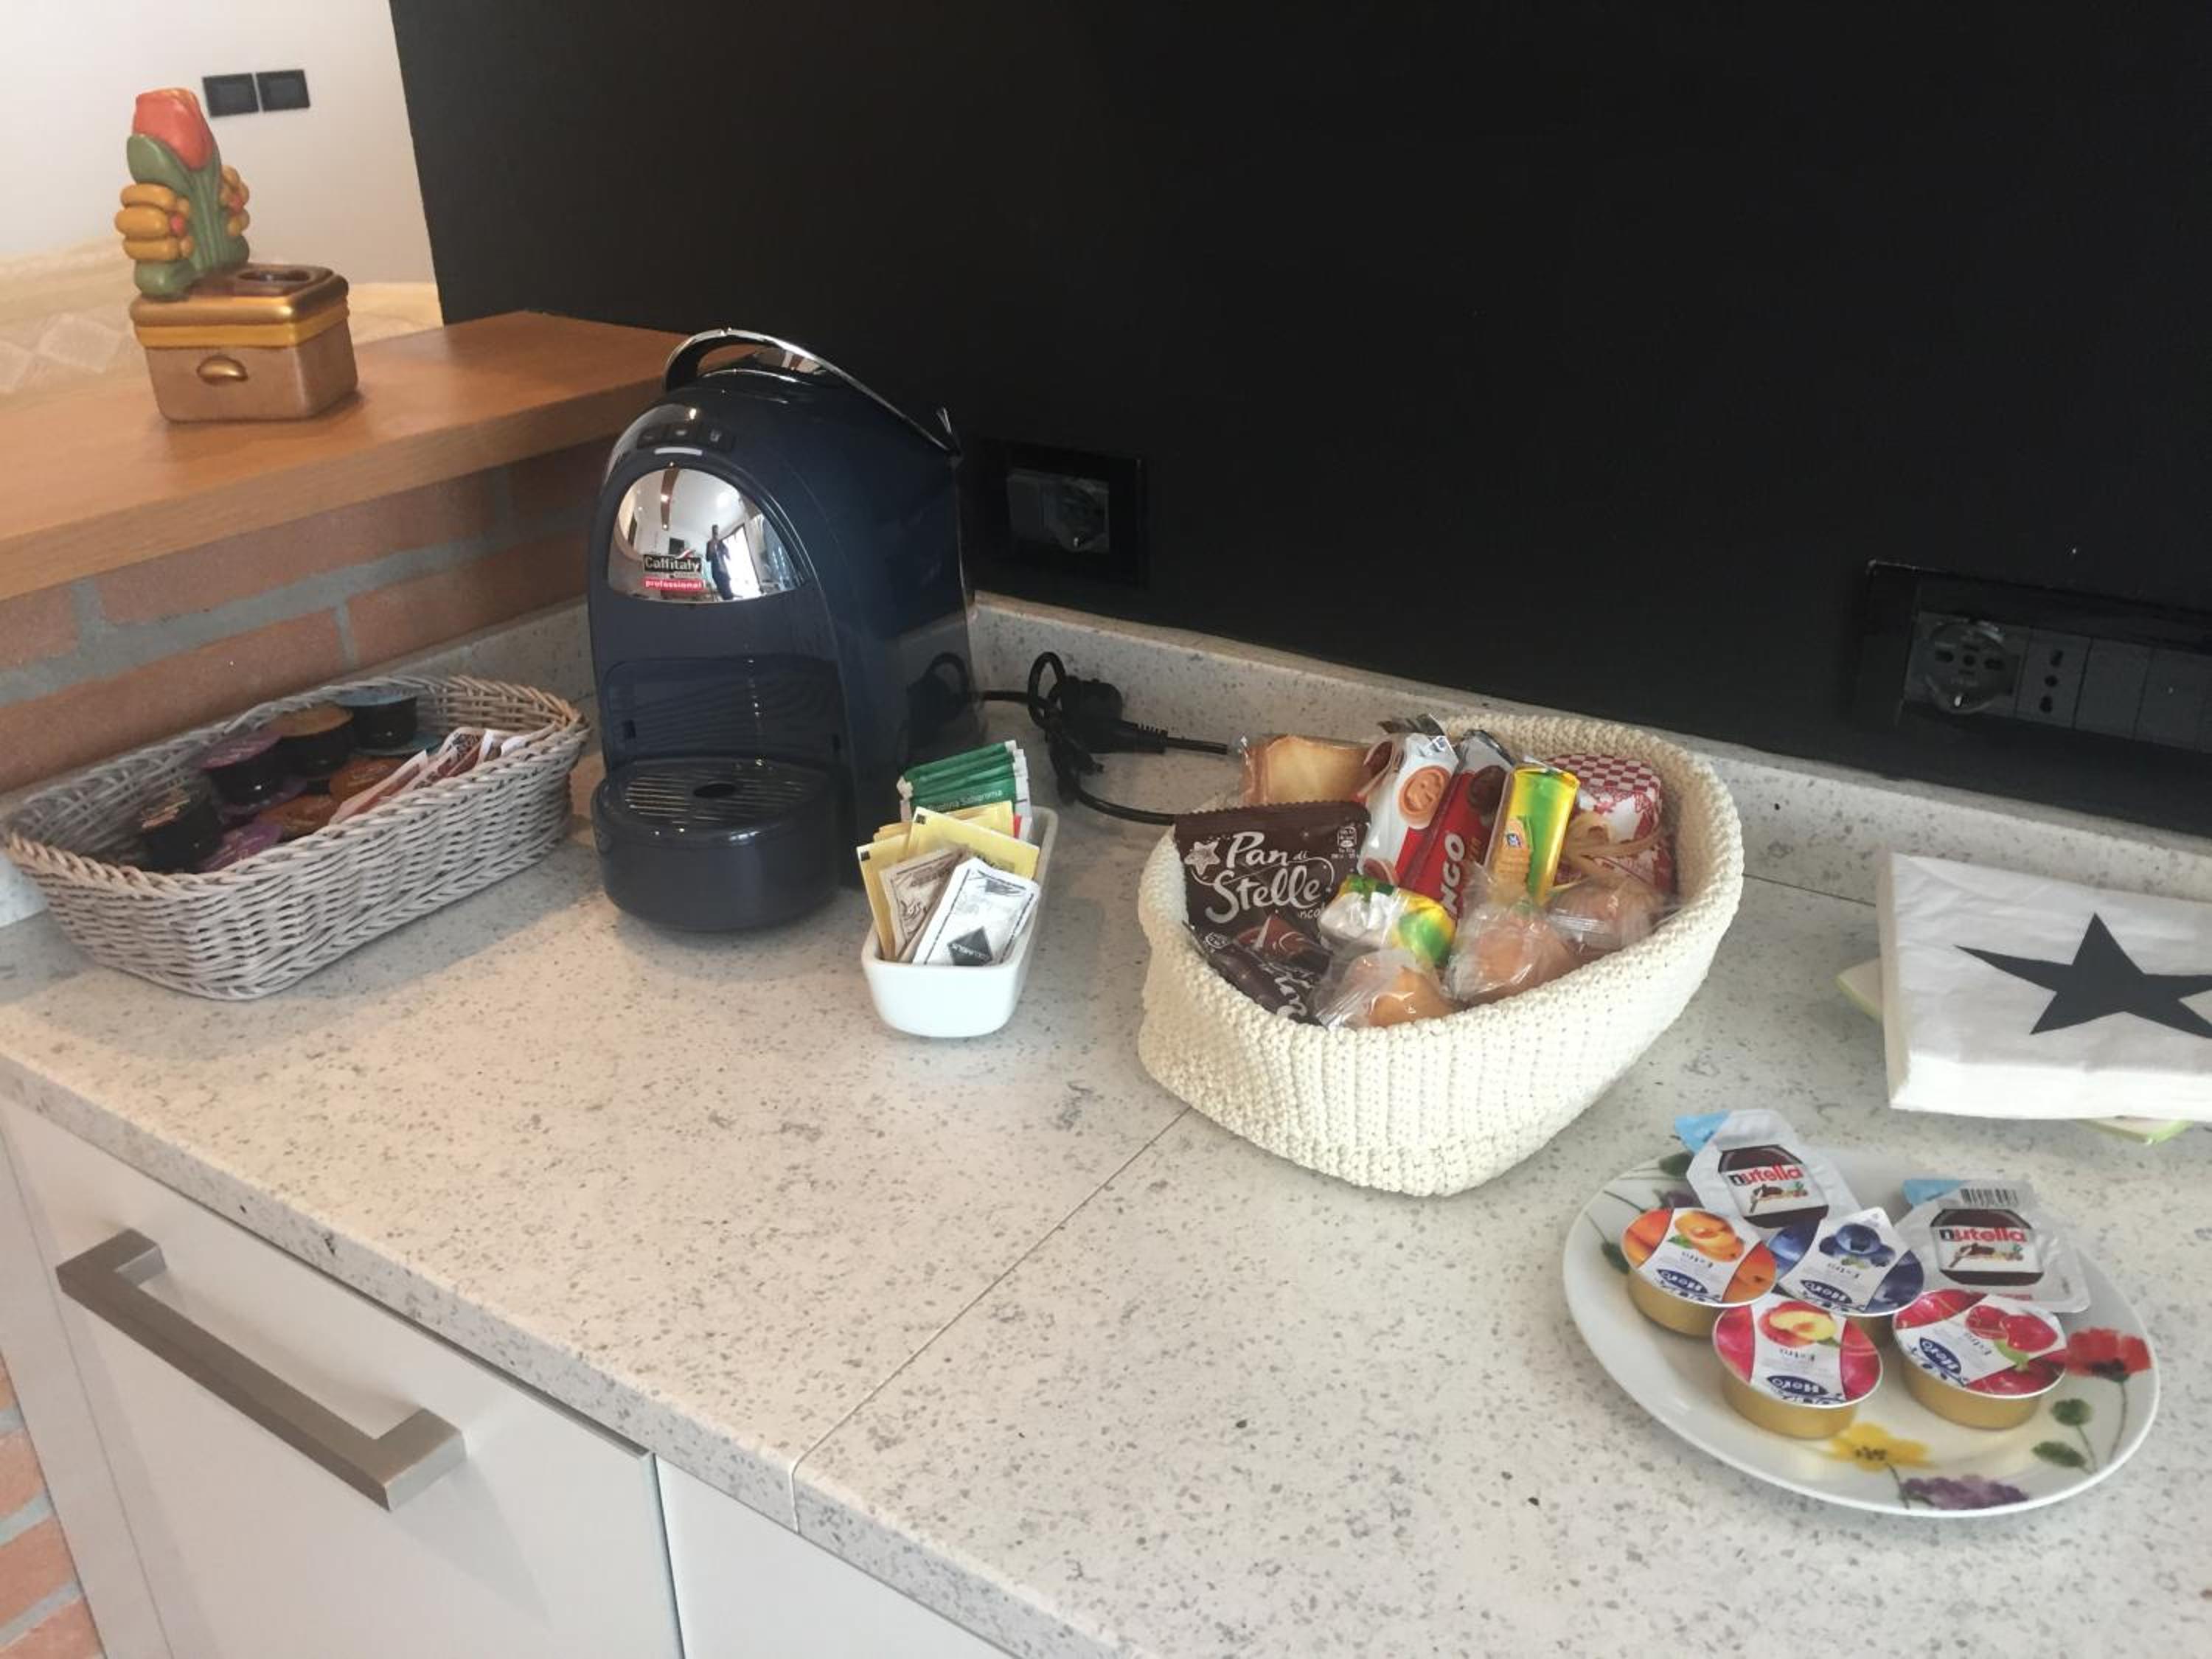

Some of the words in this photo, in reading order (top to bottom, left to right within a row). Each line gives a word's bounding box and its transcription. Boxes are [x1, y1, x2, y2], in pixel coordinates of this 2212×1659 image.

[645, 556, 700, 572] Caffitaly
[645, 579, 703, 588] professional
[1226, 831, 1289, 869] Pan
[1293, 850, 1308, 861] di
[1205, 865, 1321, 923] Stelle
[1728, 1163, 1804, 1186] nutella
[1938, 1226, 2027, 1242] nutella
[1921, 1340, 1959, 1369] Hero
[1771, 1377, 1820, 1393] Hero
